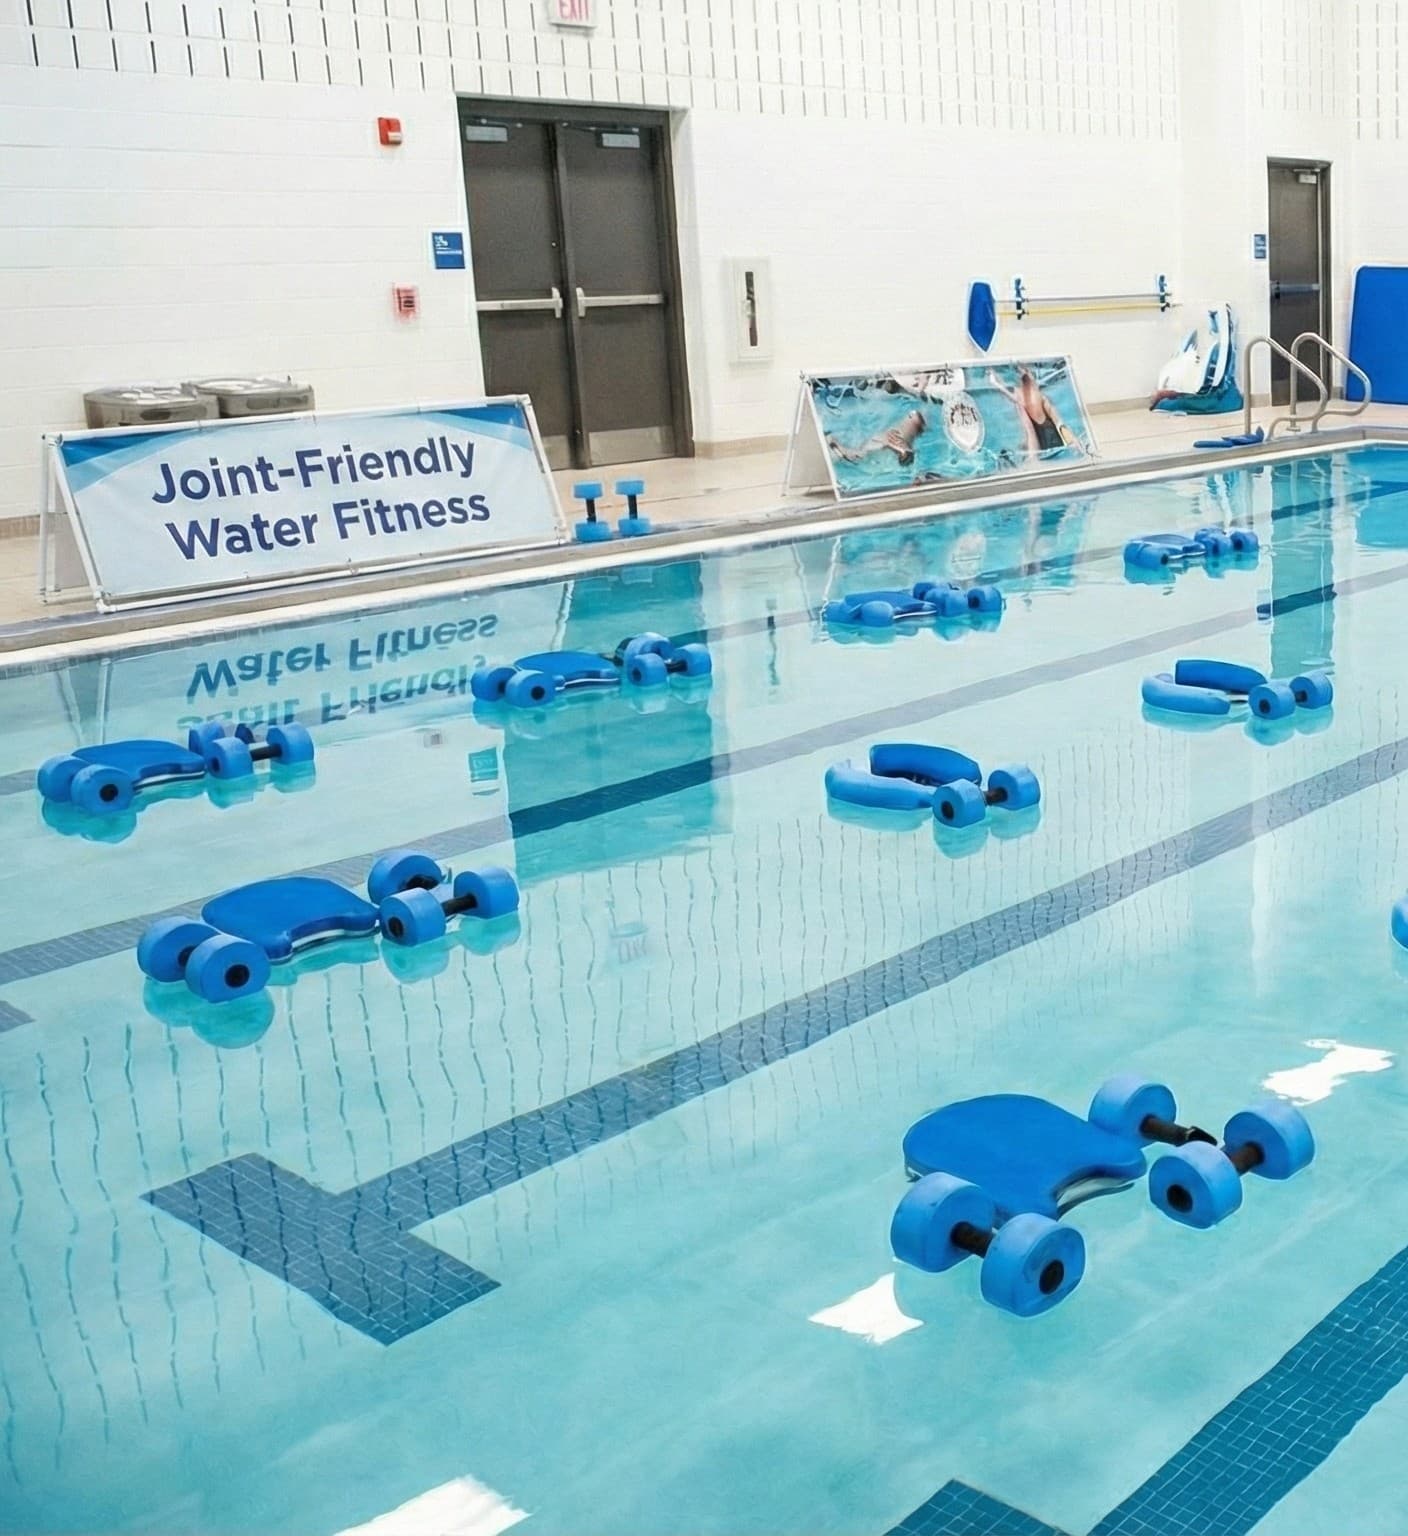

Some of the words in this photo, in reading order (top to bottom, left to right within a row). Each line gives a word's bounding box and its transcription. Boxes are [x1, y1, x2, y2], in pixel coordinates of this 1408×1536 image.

[152, 435, 476, 504] Joint-Friendly
[166, 512, 319, 561] Water
[334, 492, 491, 540] Fitness
